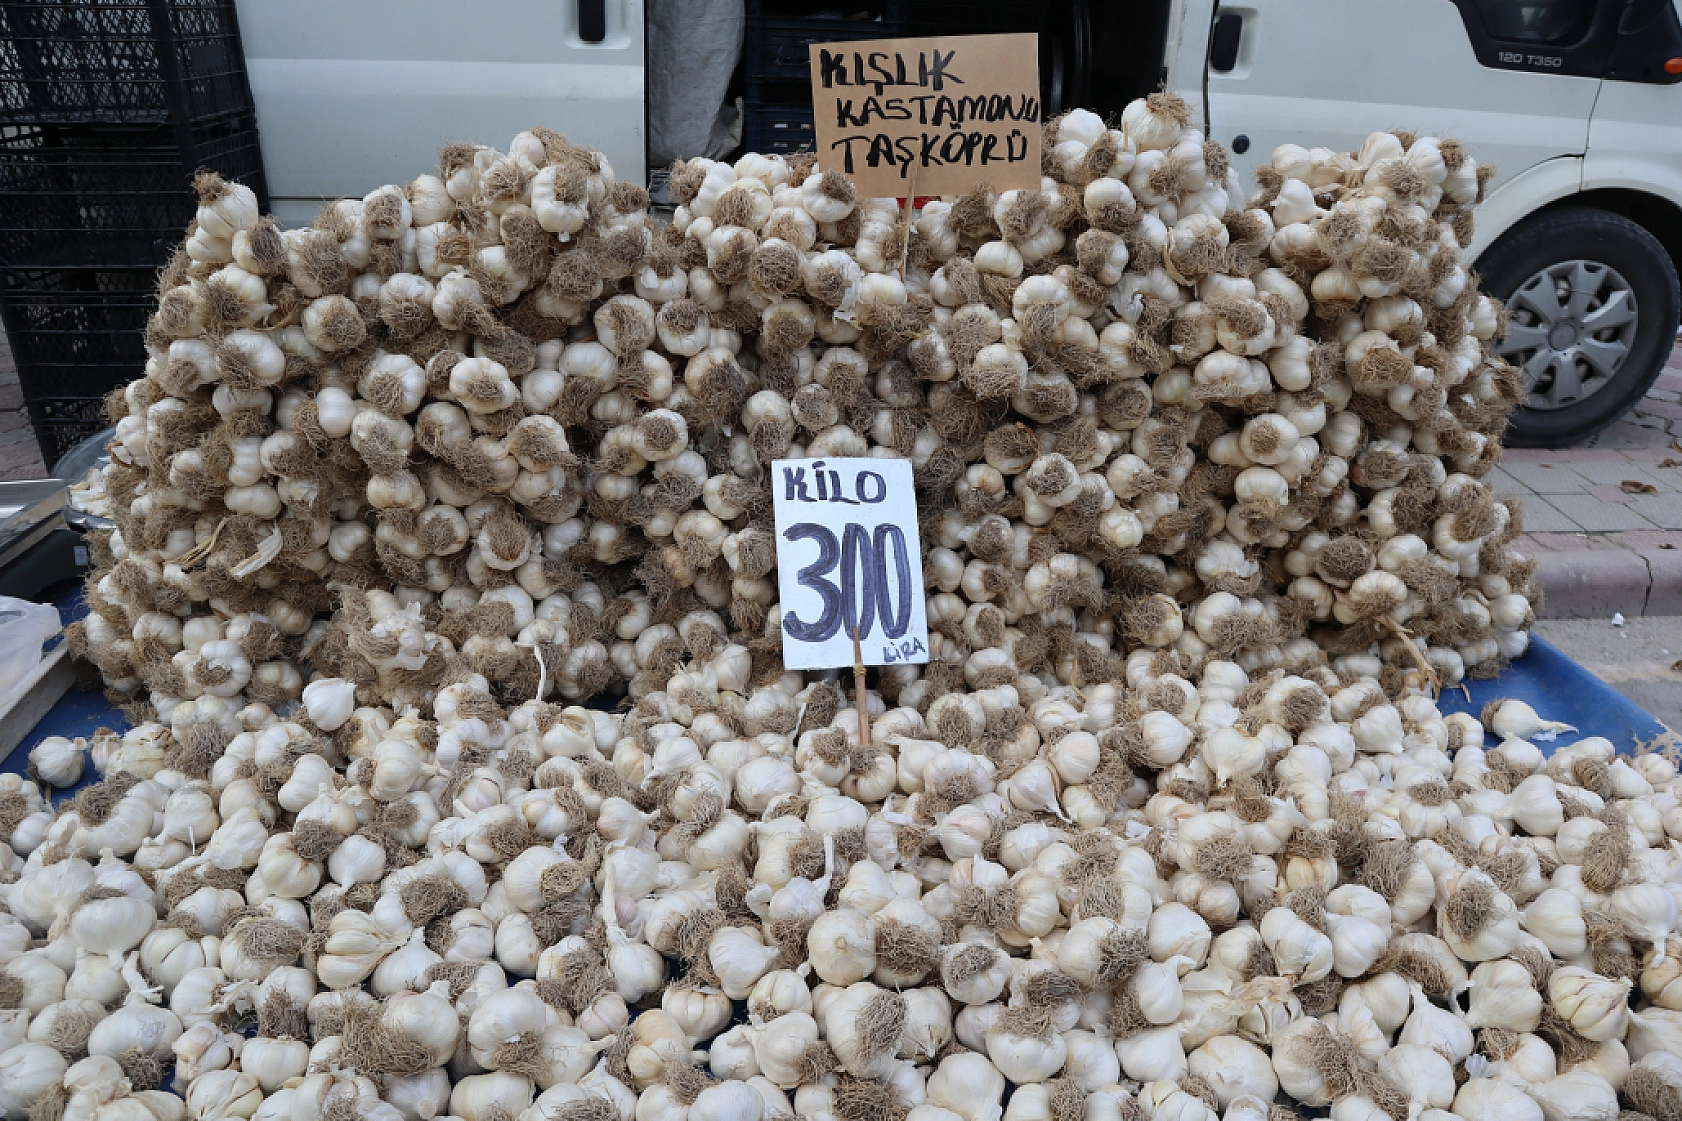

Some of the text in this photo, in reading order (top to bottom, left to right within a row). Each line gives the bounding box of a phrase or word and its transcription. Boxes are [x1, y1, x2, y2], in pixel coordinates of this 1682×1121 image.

[819, 49, 965, 96] KIŞLIK
[1526, 55, 1563, 68] T350
[836, 93, 1039, 128] KASTAMONU
[831, 121, 1028, 178] TAŞKÖPRÜ
[782, 522, 913, 643] 300
